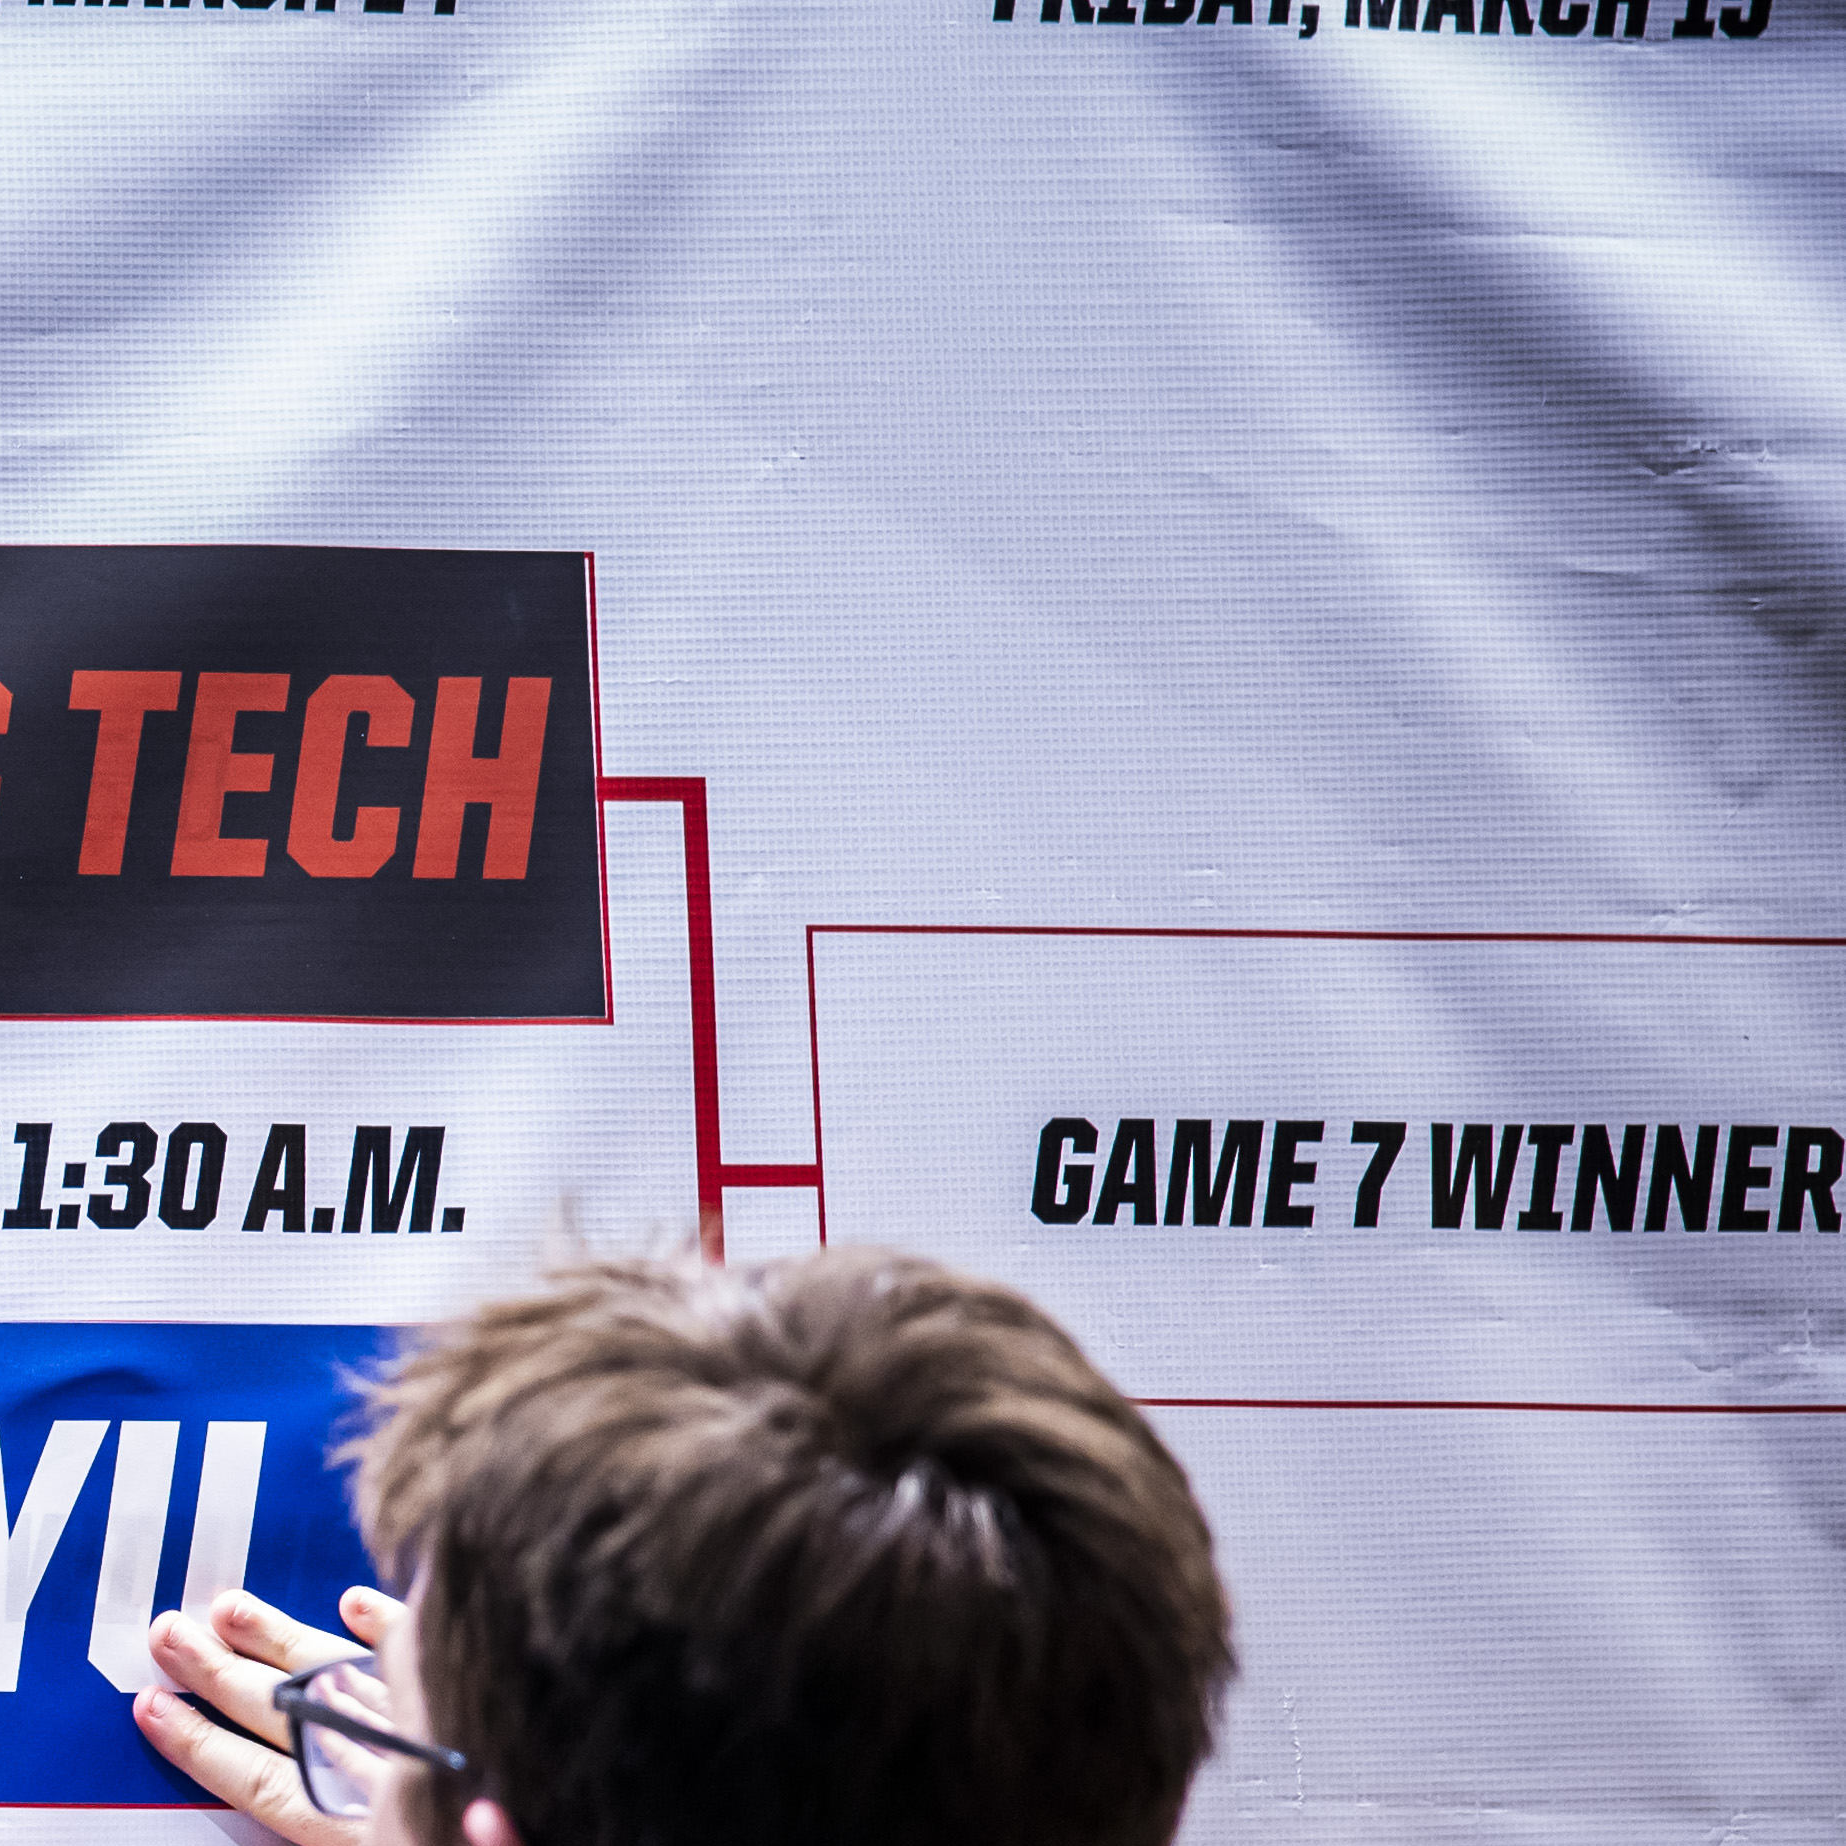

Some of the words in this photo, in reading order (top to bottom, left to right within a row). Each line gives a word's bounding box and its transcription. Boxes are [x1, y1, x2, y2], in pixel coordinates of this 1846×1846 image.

[70, 670, 552, 879] TECH
[240, 1124, 466, 1233] A.M.
[1030, 1116, 1325, 1228] GAME
[1350, 1120, 1406, 1229] 7
[1430, 1122, 1846, 1233] WINNER
